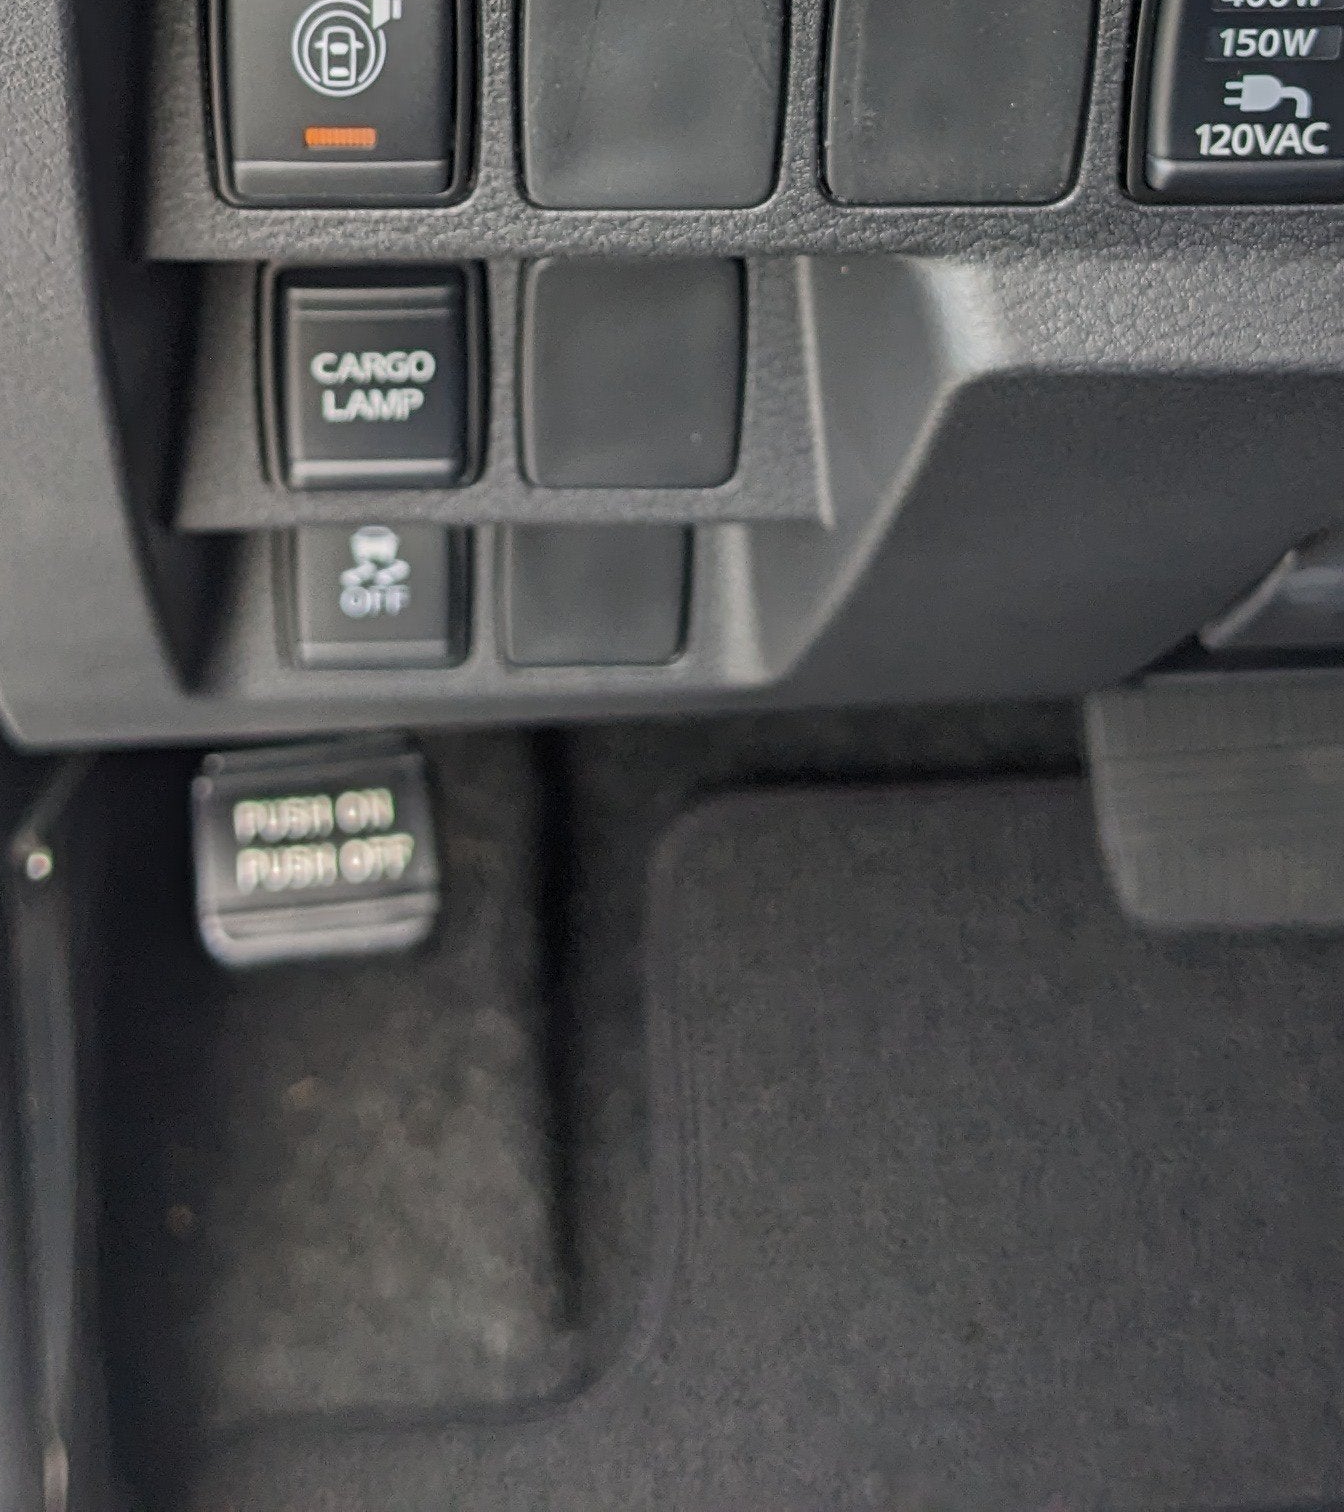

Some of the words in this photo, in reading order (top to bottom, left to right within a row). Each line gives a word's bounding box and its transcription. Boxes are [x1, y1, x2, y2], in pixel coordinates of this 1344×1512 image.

[1219, 27, 1320, 58] 150W
[1194, 121, 1331, 157] 120VAC
[310, 350, 436, 385] CARGO
[322, 388, 425, 423] LAMP
[233, 794, 334, 843] PUSH
[335, 788, 396, 835] ON
[236, 842, 338, 896] PUSH
[339, 833, 415, 884] OFF
